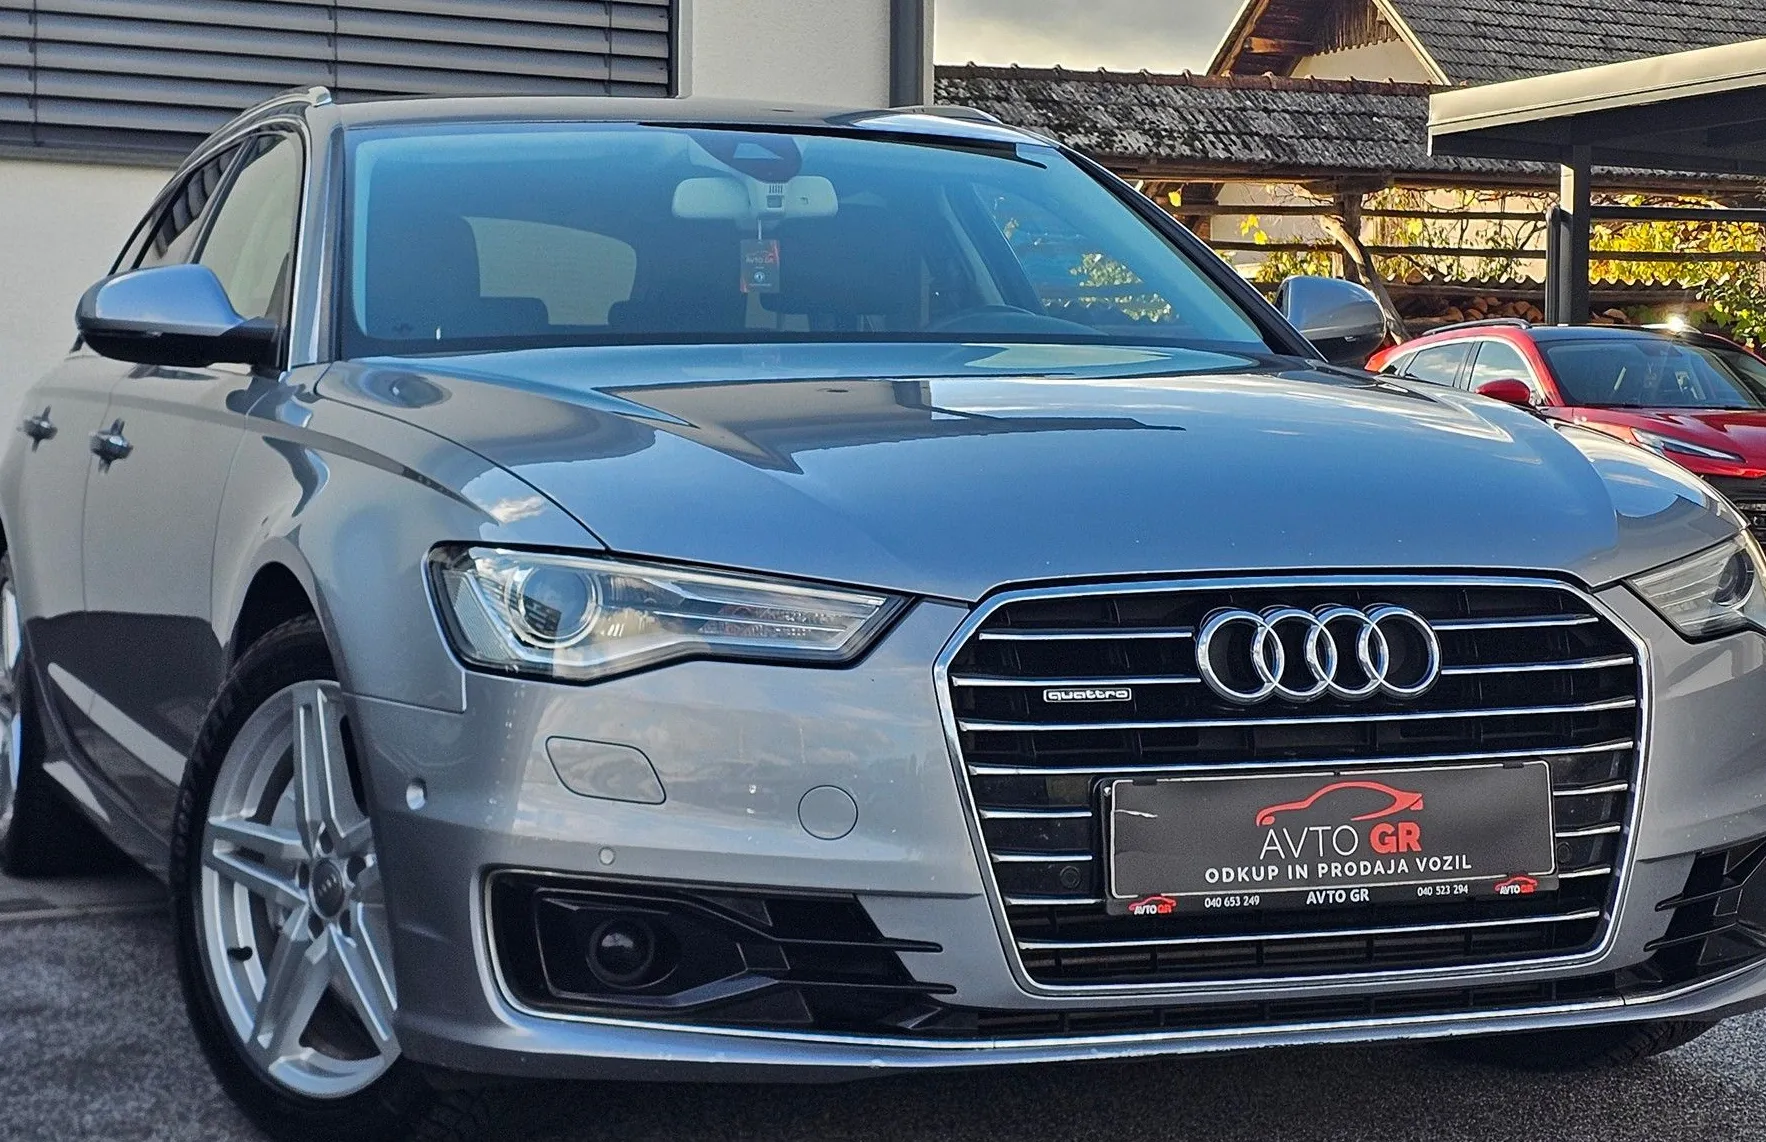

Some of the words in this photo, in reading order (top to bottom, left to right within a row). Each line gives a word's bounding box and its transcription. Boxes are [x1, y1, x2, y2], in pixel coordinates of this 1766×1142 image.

[1047, 689, 1128, 701] quattro
[1259, 825, 1359, 860] AVTO
[1369, 822, 1422, 854] GR
[1204, 865, 1279, 884] ODKUP
[1287, 863, 1308, 880] IN
[1317, 858, 1409, 879] PRODAJA
[1415, 854, 1472, 873] VOZIL
[1417, 886, 1433, 897] 040
[1435, 885, 1451, 896] 523
[1453, 884, 1468, 895] 294
[1500, 884, 1520, 895] AVTO
[1204, 897, 1222, 908] 040
[1223, 896, 1241, 907] 653
[1243, 895, 1260, 906] 249
[1306, 889, 1347, 905] AVTO
[1349, 888, 1370, 902] GR
[1133, 904, 1157, 915] AVTO
